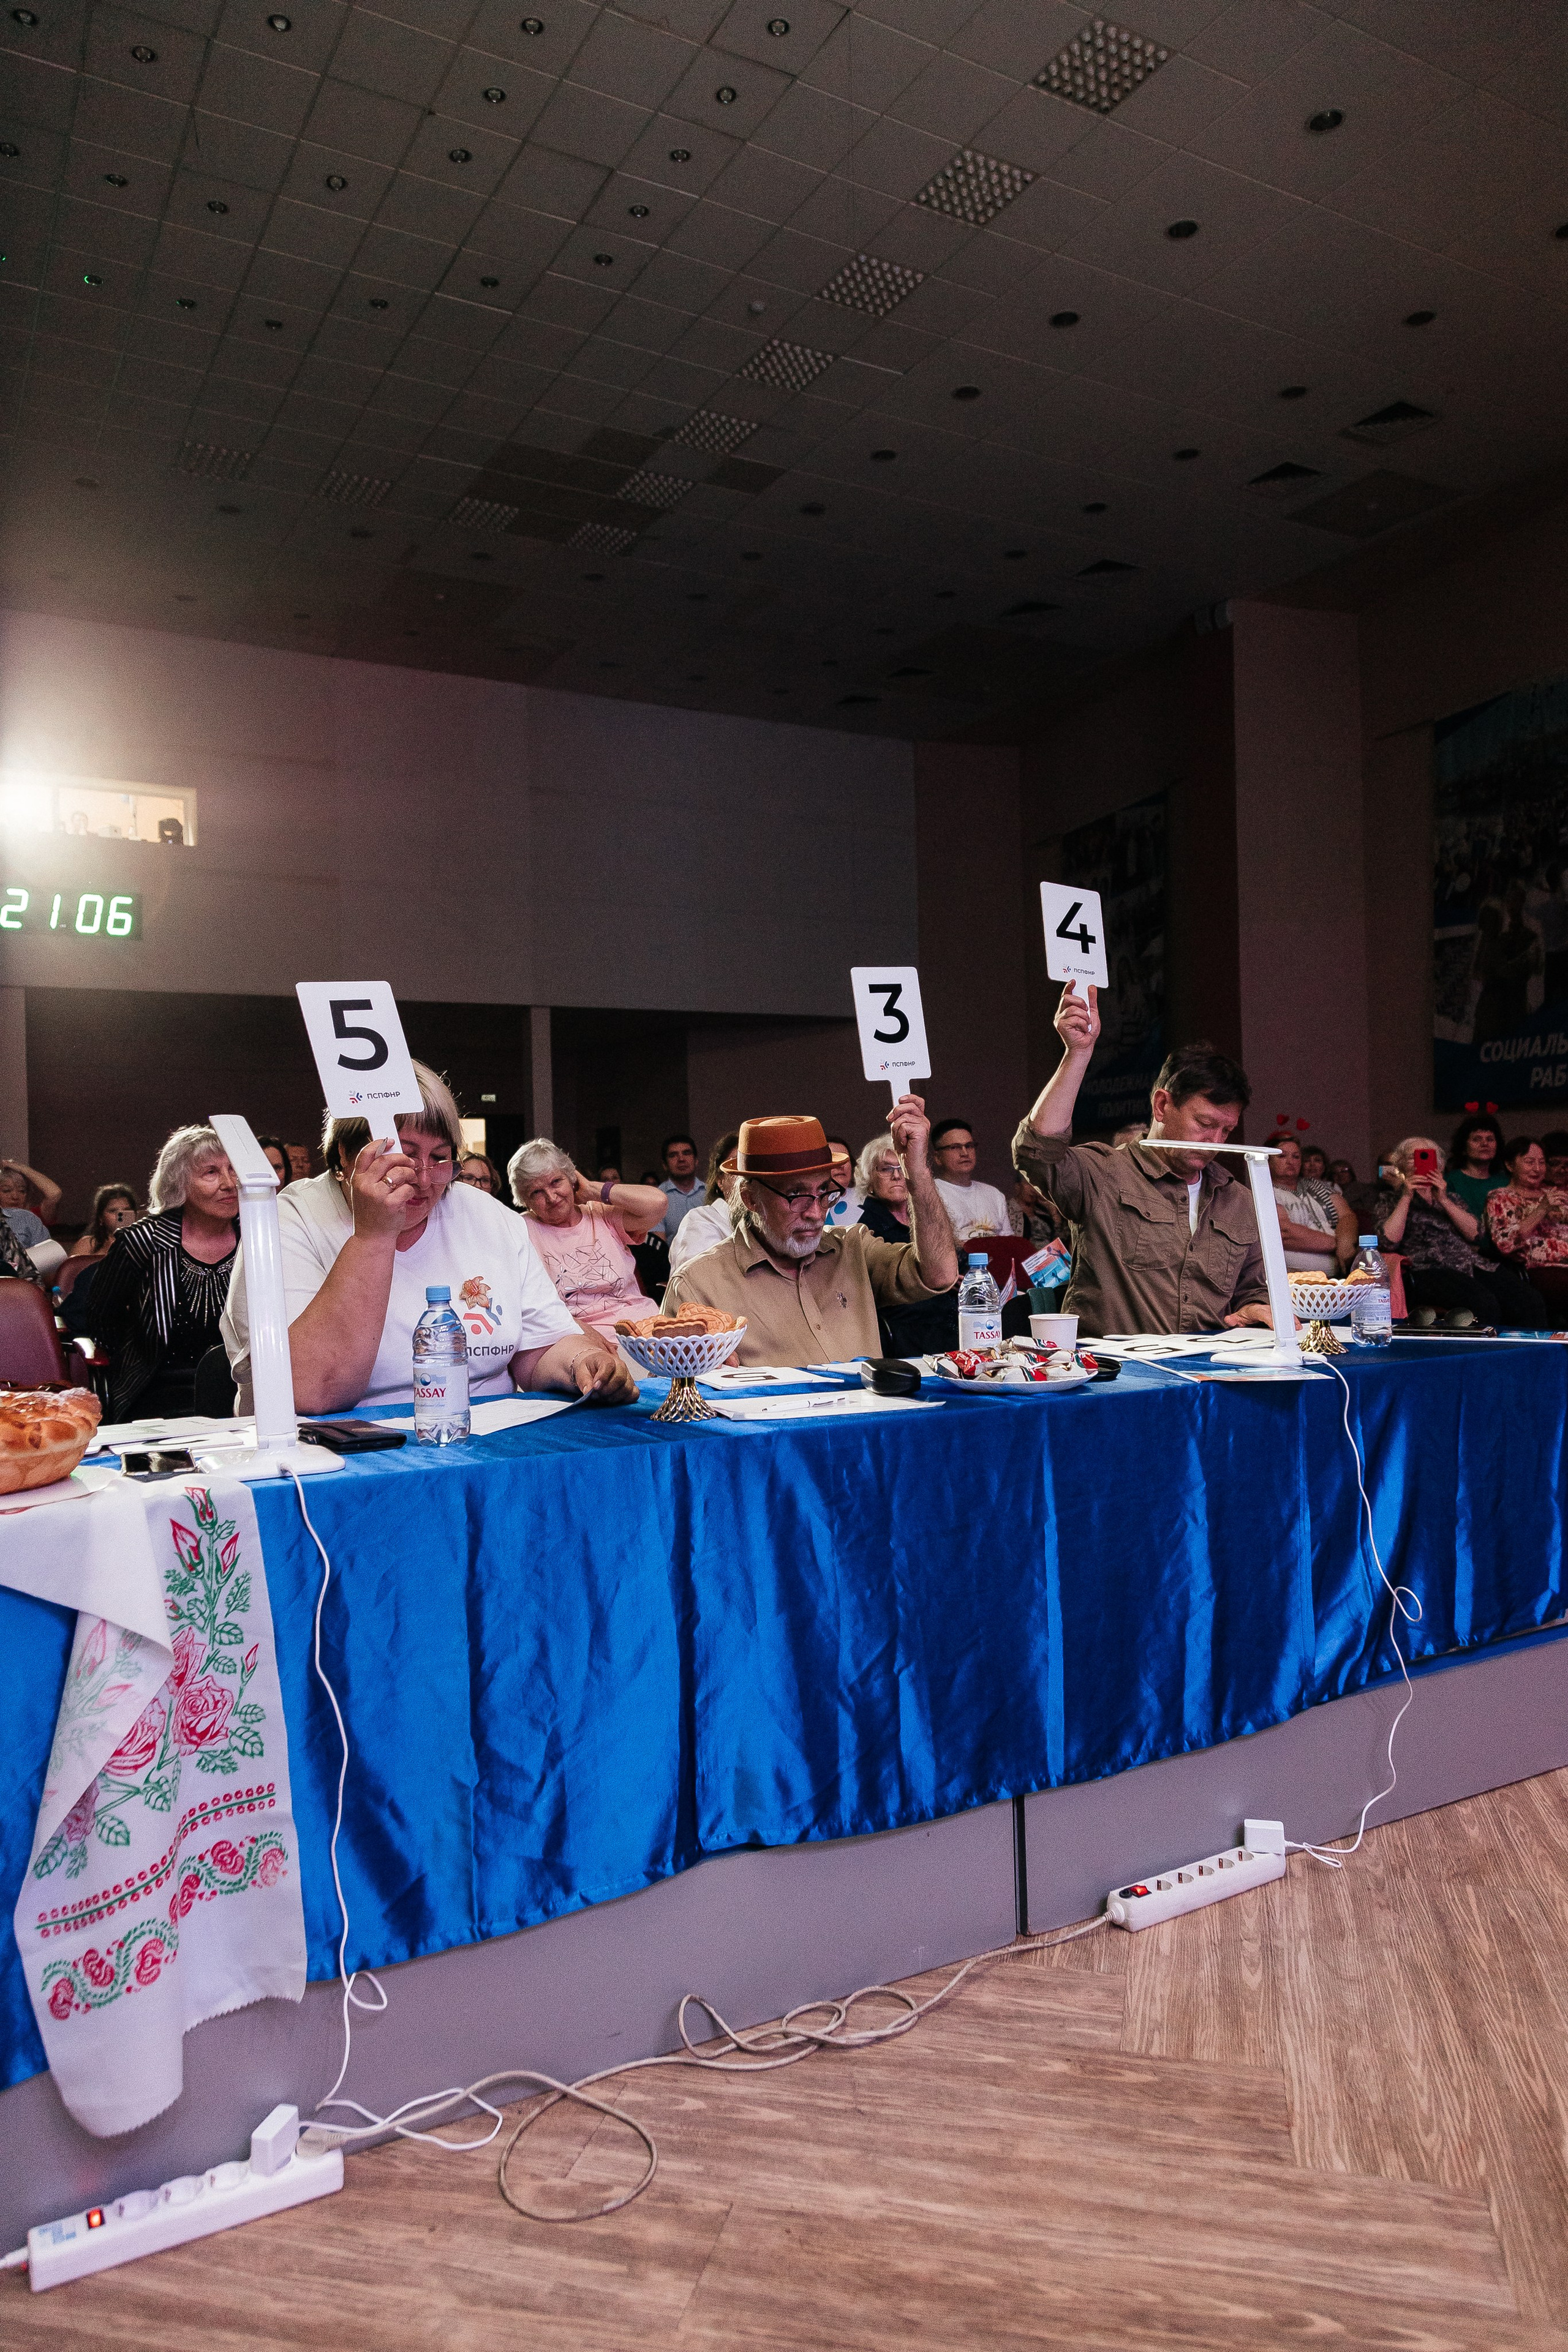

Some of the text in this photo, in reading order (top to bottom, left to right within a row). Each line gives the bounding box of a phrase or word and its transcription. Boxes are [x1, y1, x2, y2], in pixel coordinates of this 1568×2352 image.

[1056, 902, 1096, 954] 4
[868, 983, 910, 1044] 3
[329, 999, 389, 1071] 5
[1480, 1033, 1568, 1063] СОЦИАЛЬ
[367, 1091, 401, 1099] ПСПФНР
[1529, 1064, 1567, 1088] РАБ
